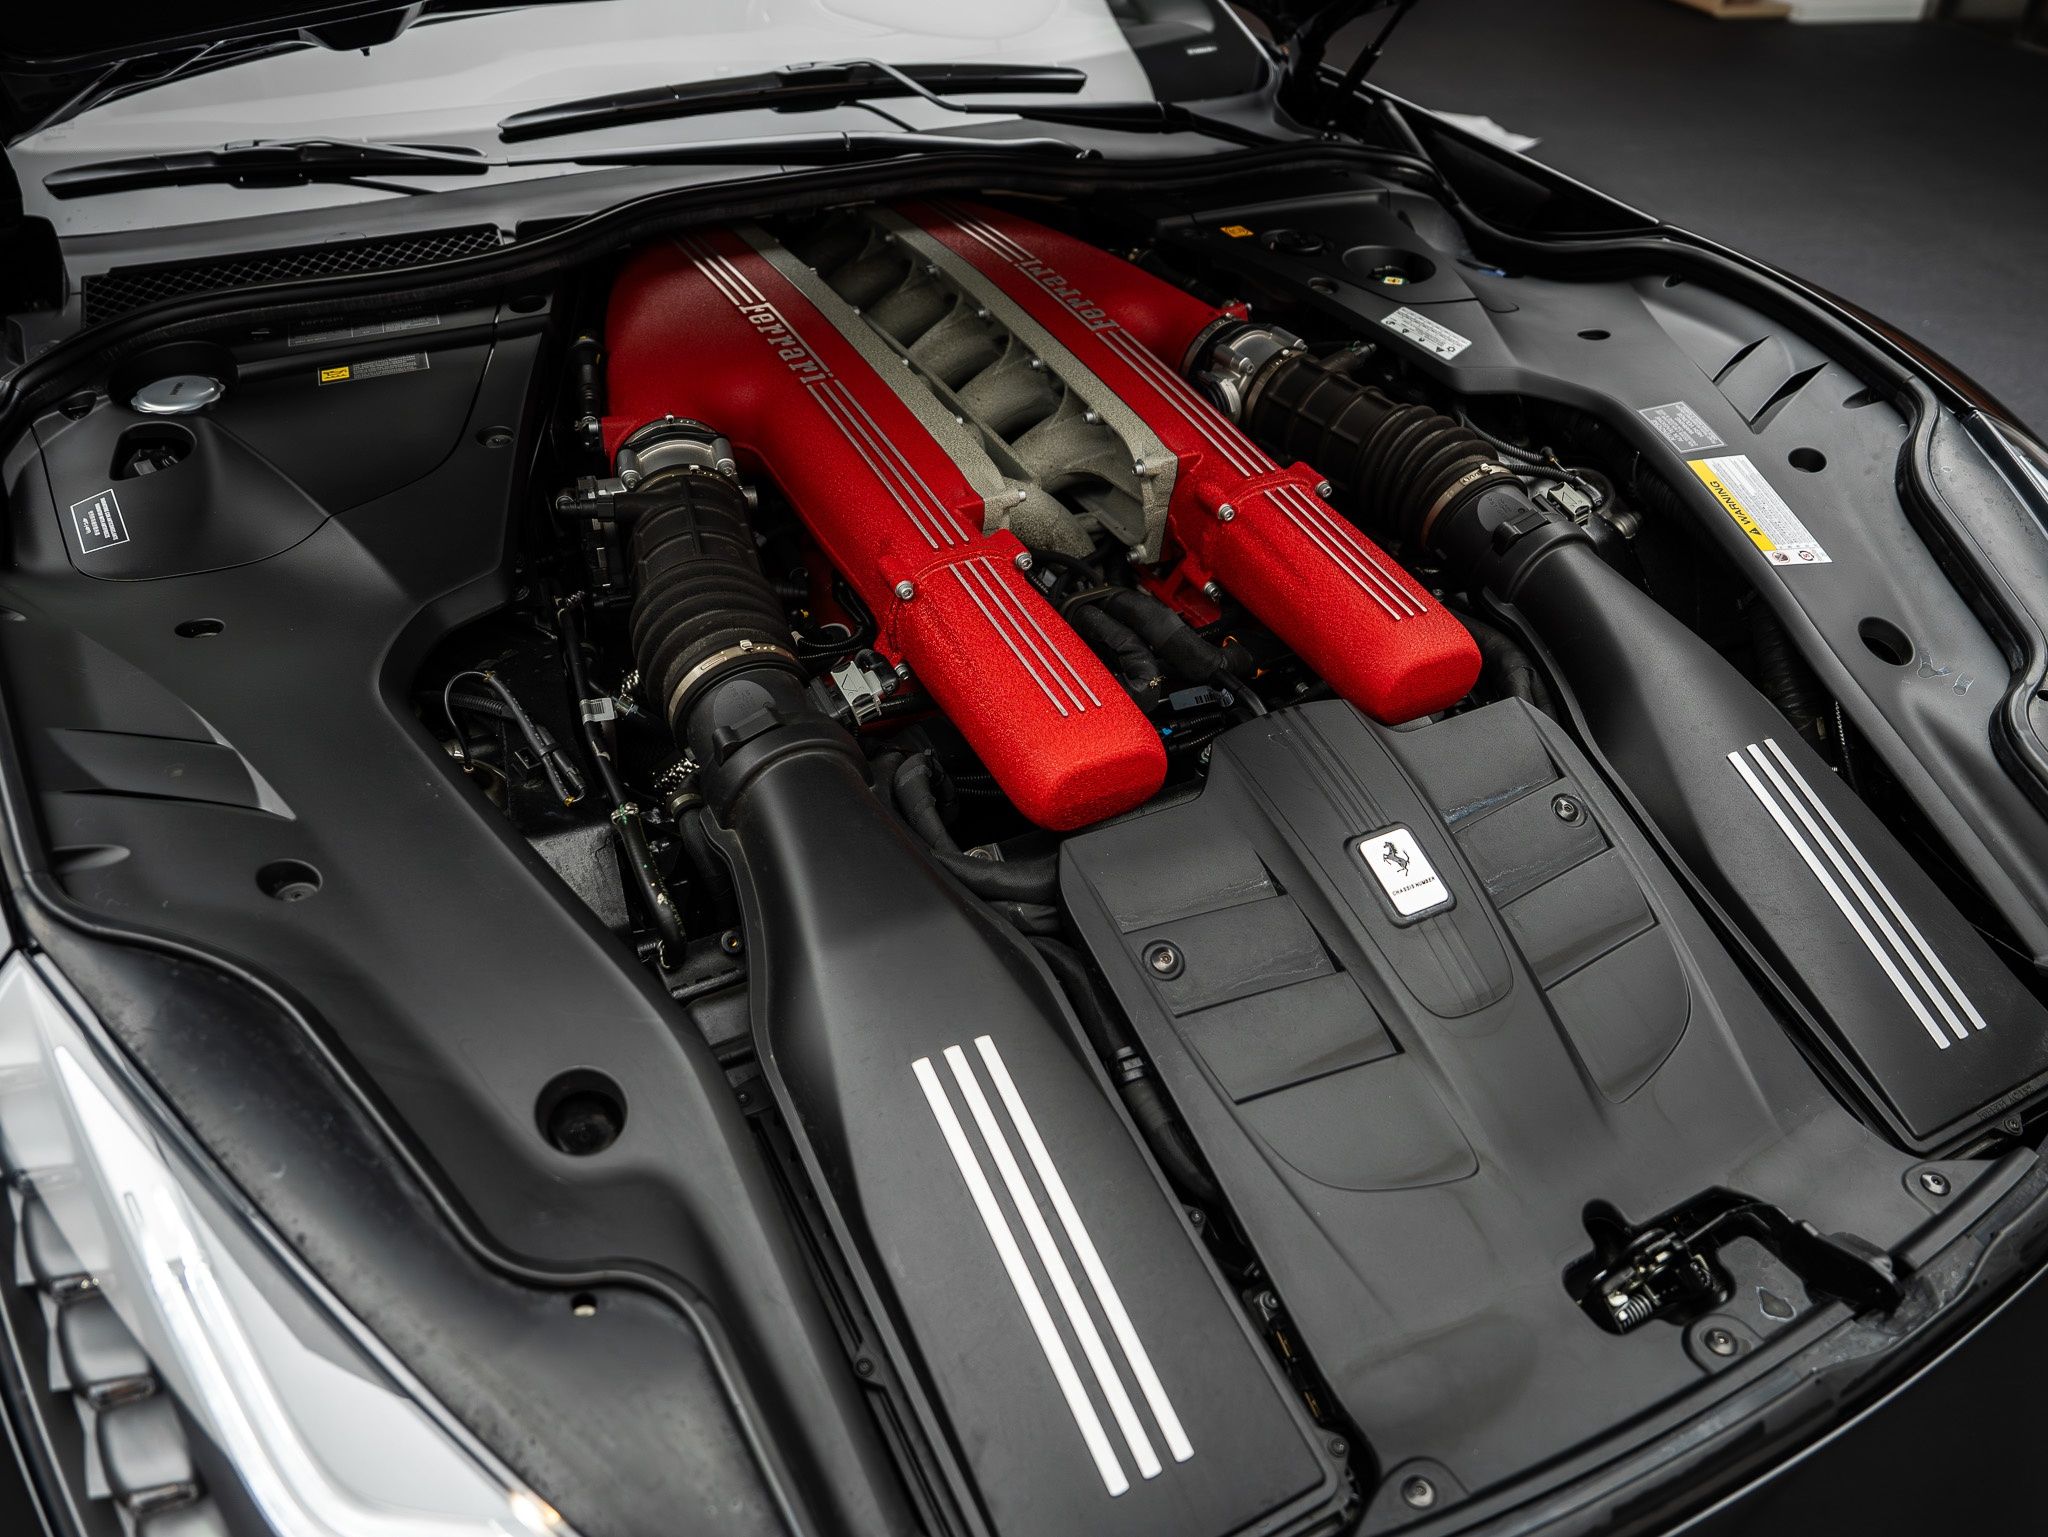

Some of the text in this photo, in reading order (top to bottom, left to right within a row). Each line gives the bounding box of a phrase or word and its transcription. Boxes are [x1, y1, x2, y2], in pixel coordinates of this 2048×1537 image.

[1014, 259, 1120, 331] Ferrari
[739, 302, 834, 384] Ferrari
[1710, 481, 1751, 525] WARNING
[1392, 876, 1435, 896] CHASSIS NUMBER
